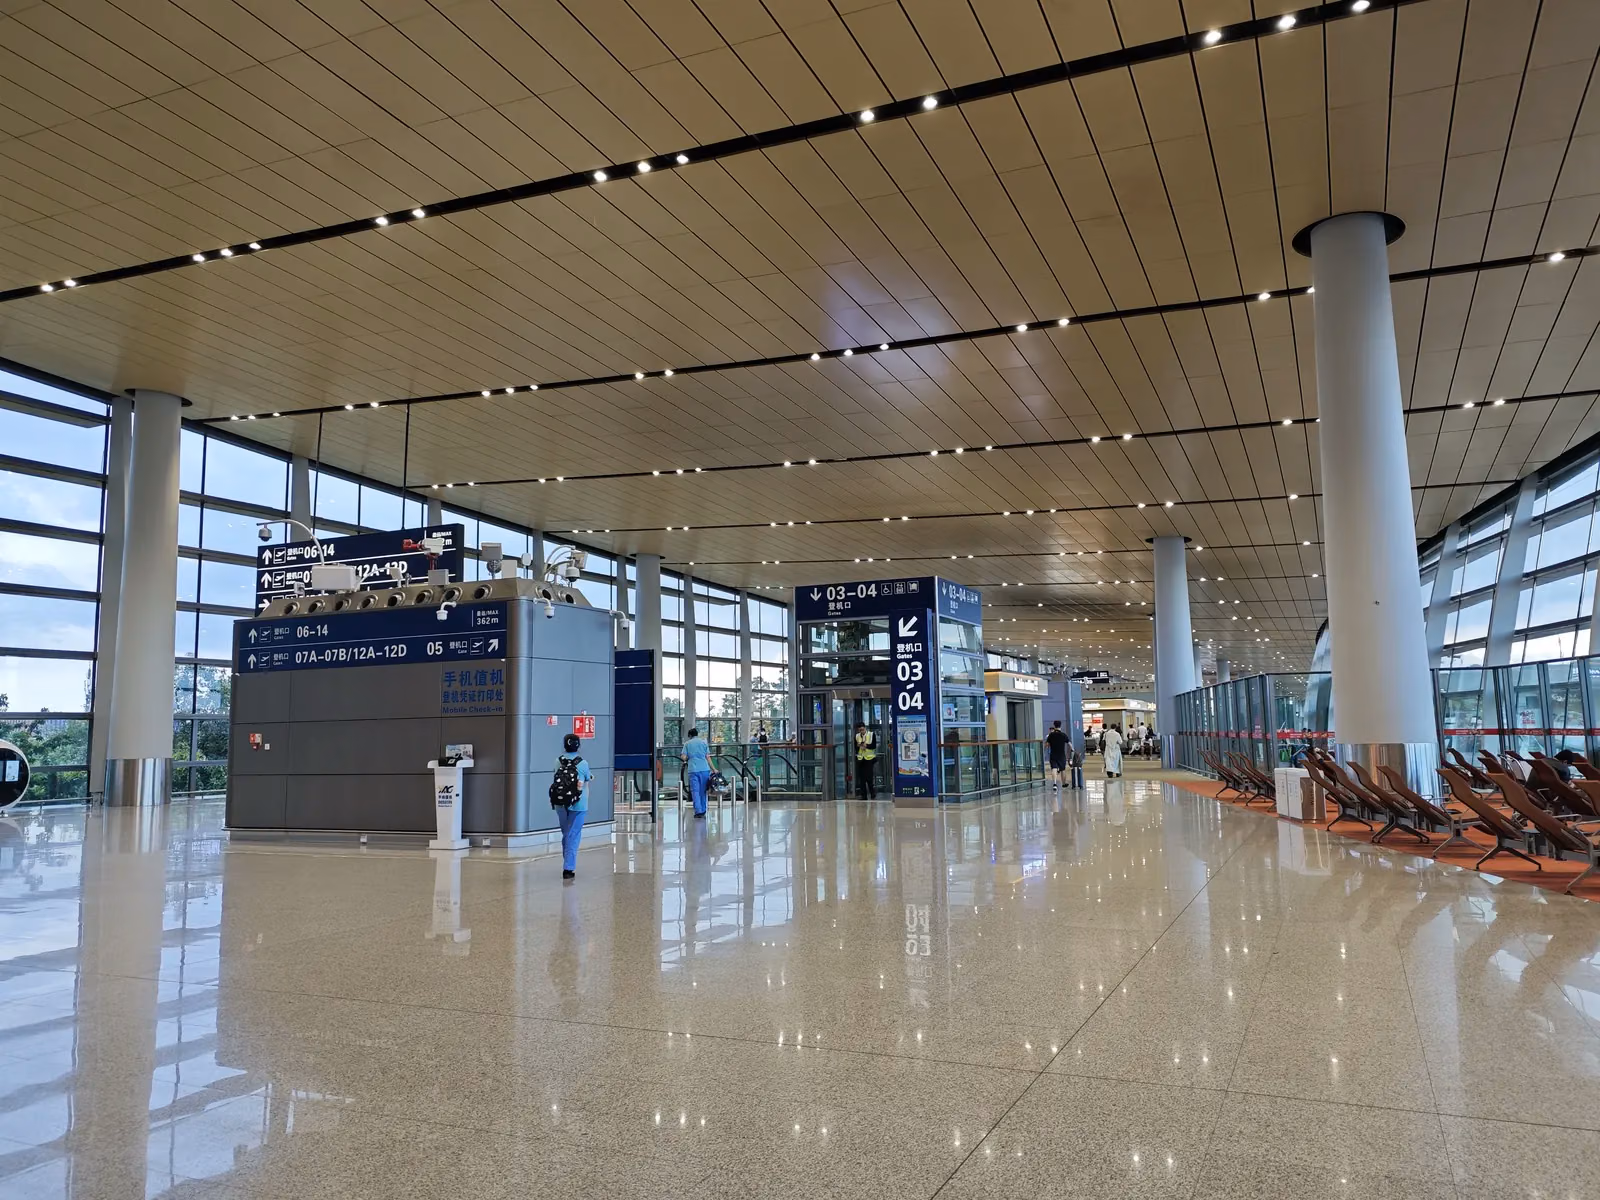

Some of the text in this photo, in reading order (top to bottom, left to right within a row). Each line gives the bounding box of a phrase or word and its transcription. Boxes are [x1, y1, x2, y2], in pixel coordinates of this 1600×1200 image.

[826, 584, 878, 601] 03-04
[828, 601, 851, 611] 登机口
[296, 624, 328, 638] 06-14
[295, 643, 407, 664] 07A-07B/12A-12D
[426, 641, 444, 656] 05
[896, 643, 922, 652] 登机口
[444, 668, 504, 687] 手机值机
[896, 660, 923, 681] 03
[898, 691, 924, 710] 04
[442, 705, 503, 714] Mobile Check-in
